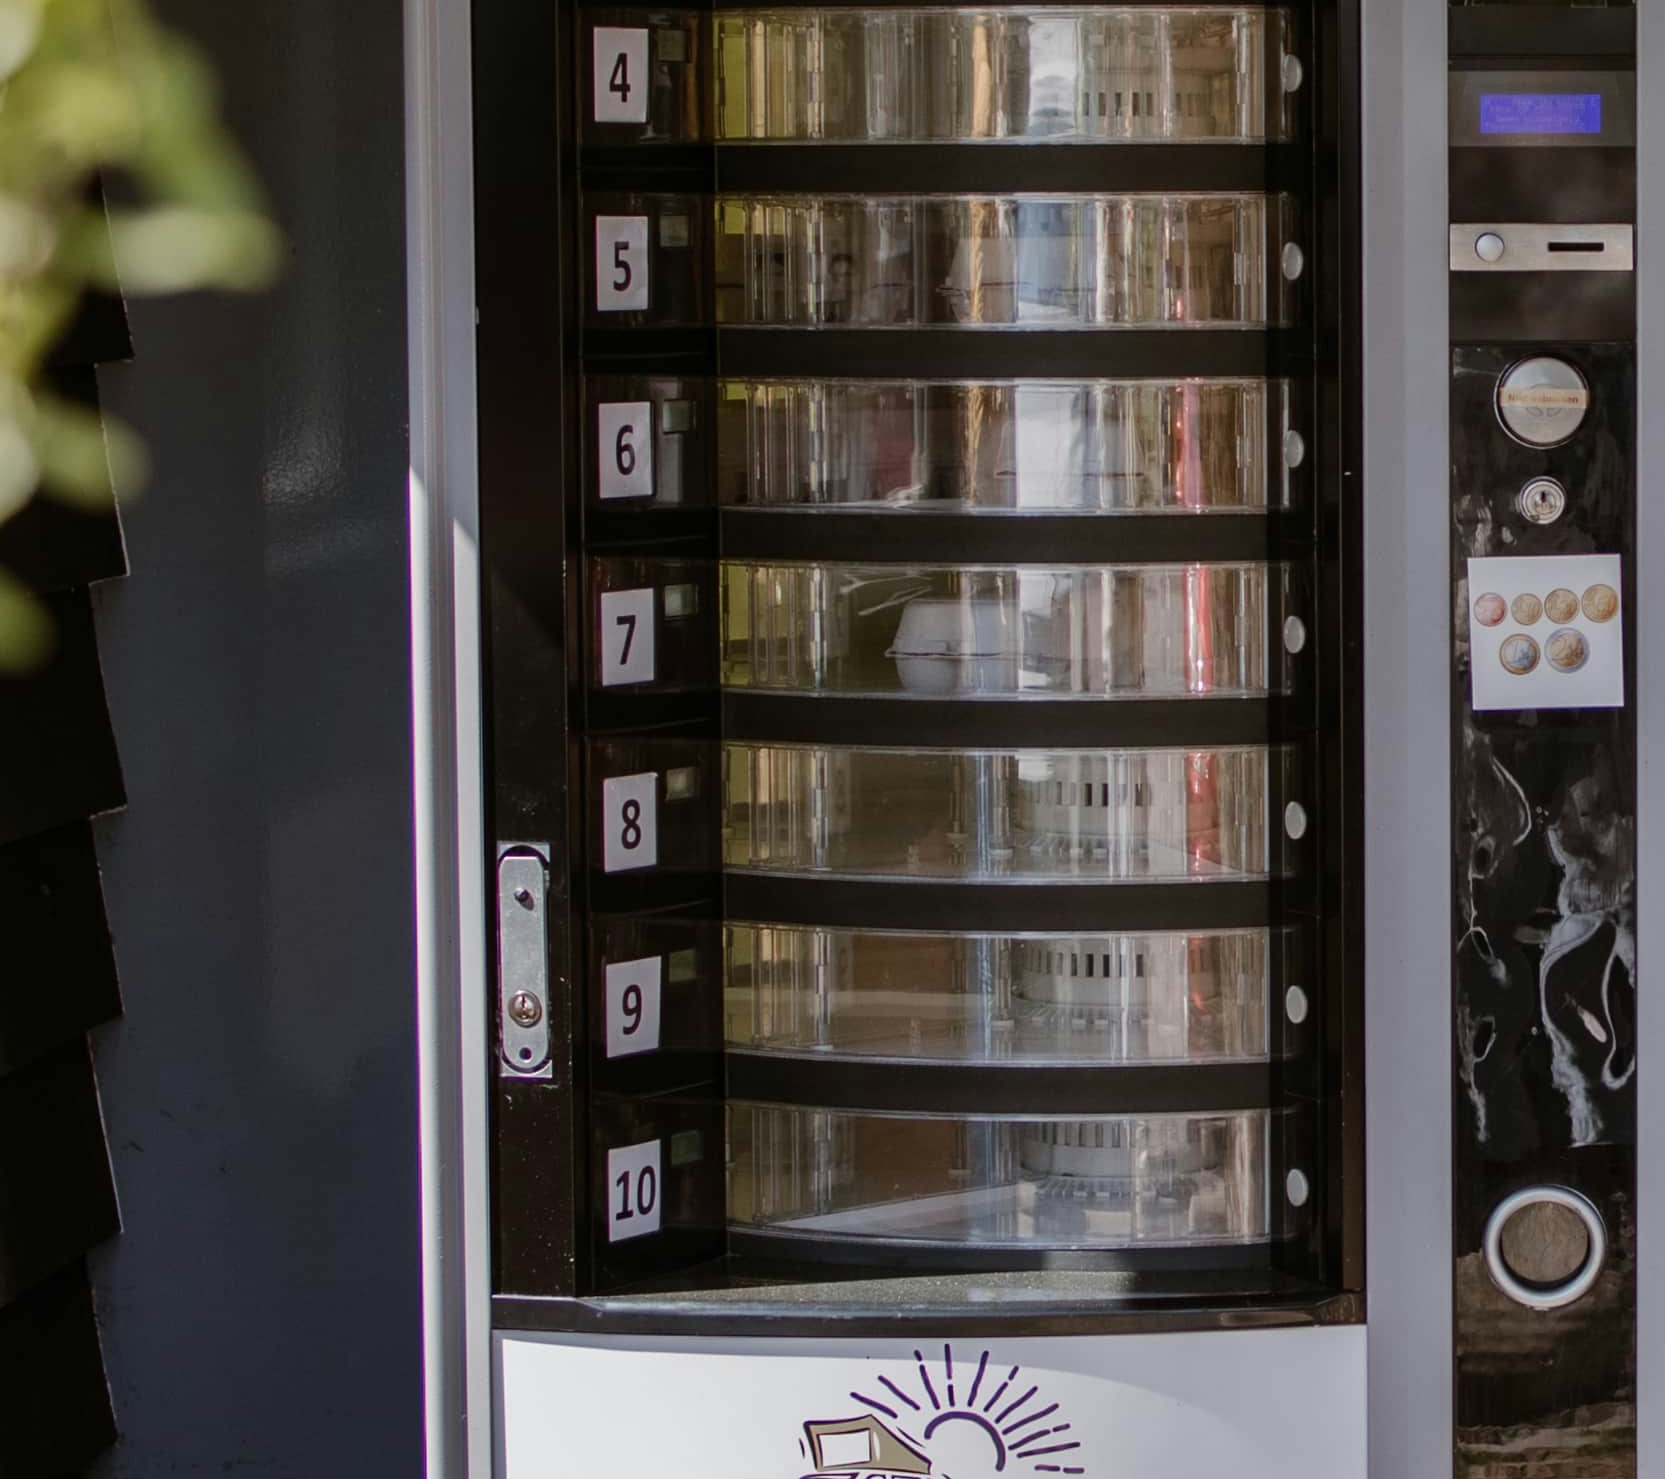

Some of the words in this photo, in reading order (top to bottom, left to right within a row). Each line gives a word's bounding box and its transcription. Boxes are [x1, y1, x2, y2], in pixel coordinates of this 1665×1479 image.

[607, 51, 632, 105] 4
[611, 239, 633, 294] 5
[614, 423, 637, 477] 6
[615, 613, 638, 667] 7
[619, 797, 643, 851] 8
[620, 983, 644, 1037] 9
[614, 1164, 657, 1222] 10
